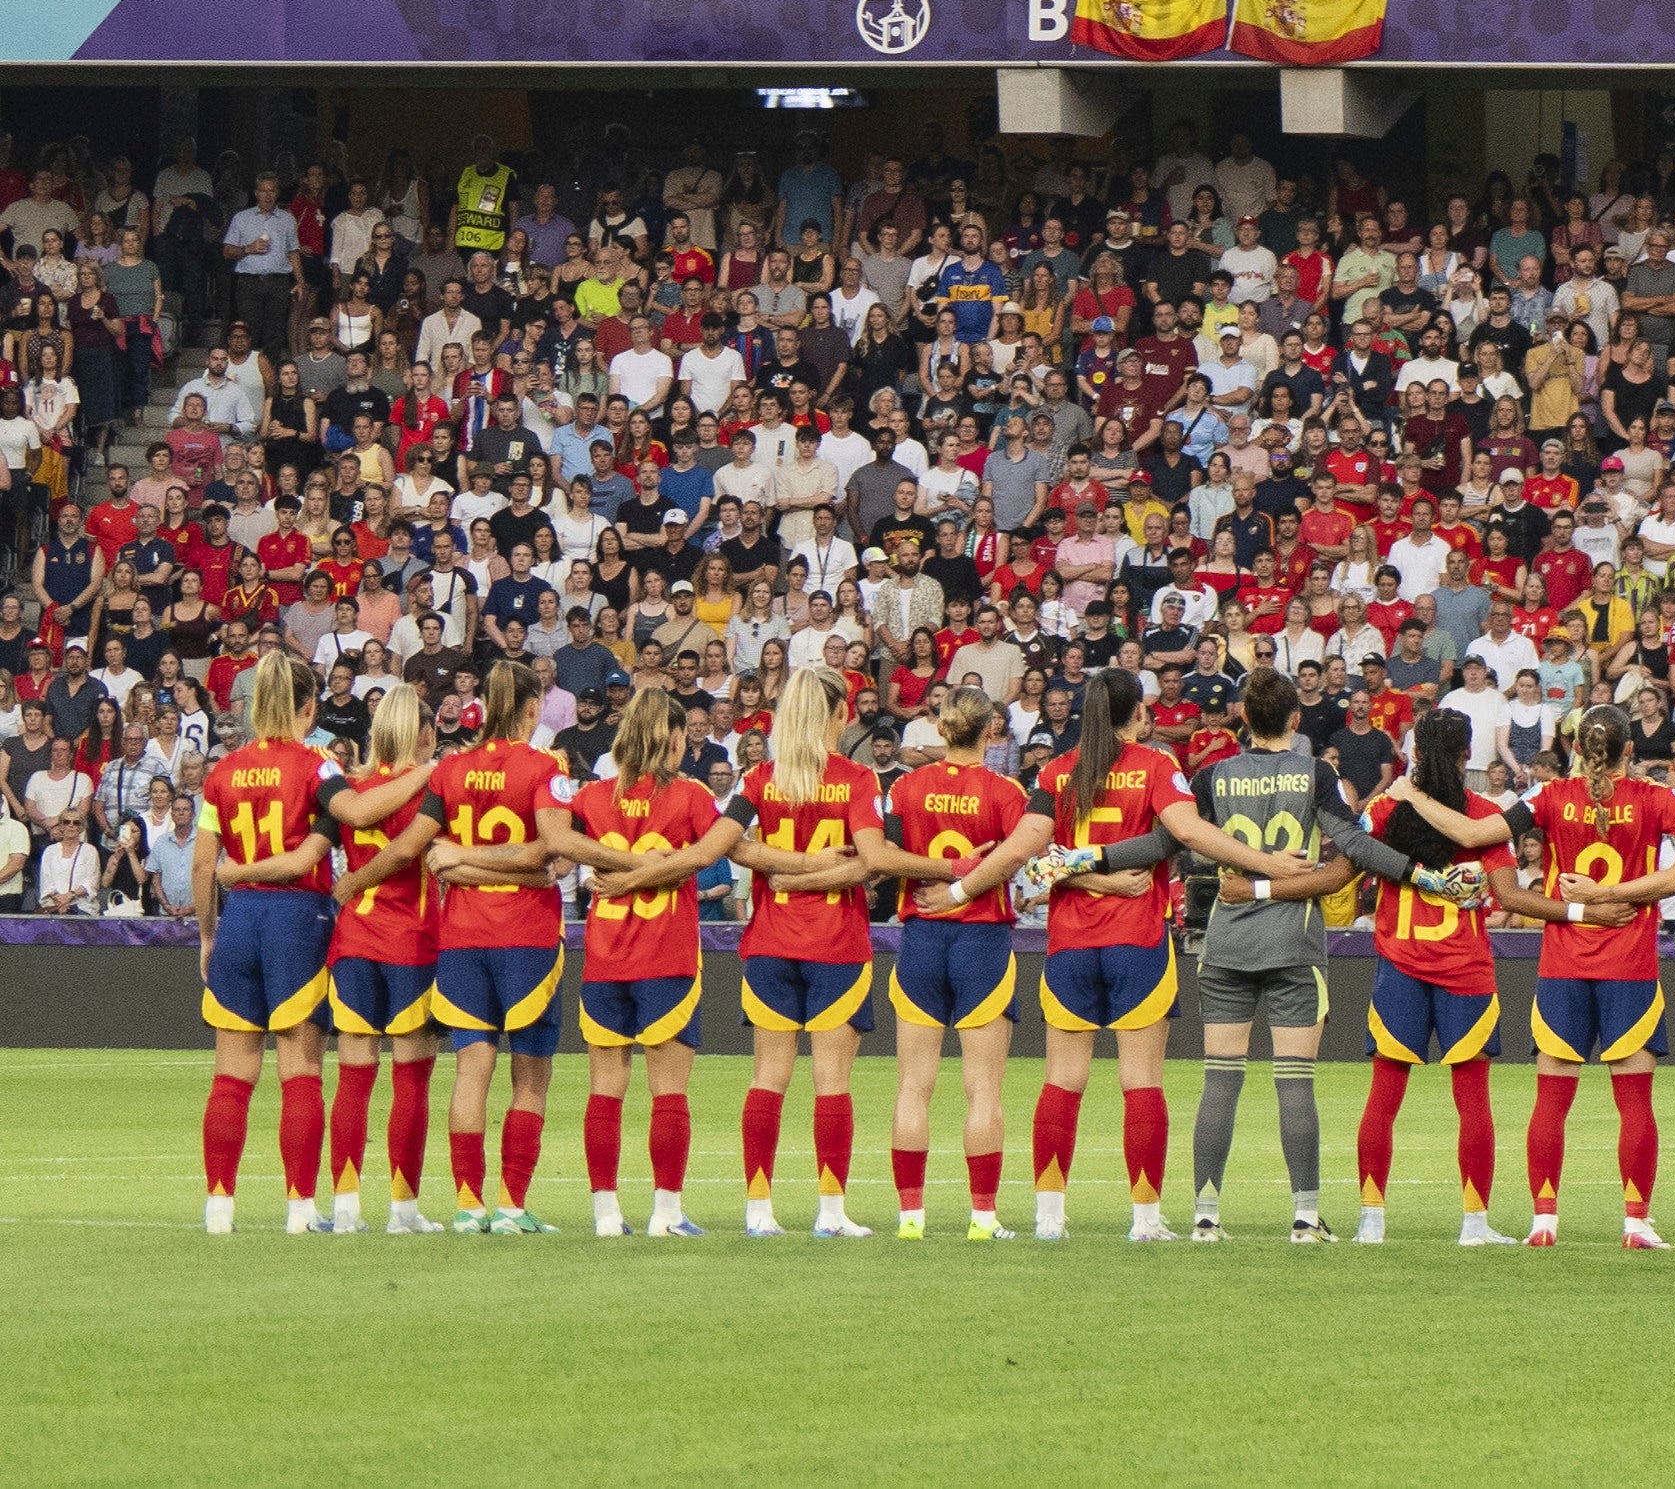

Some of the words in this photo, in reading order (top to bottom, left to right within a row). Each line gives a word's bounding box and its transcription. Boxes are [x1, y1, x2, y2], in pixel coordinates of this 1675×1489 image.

[230, 766, 283, 789] ALEXIA
[464, 769, 506, 791] PATRI
[924, 793, 980, 816] ESTHER
[231, 800, 286, 865] 11
